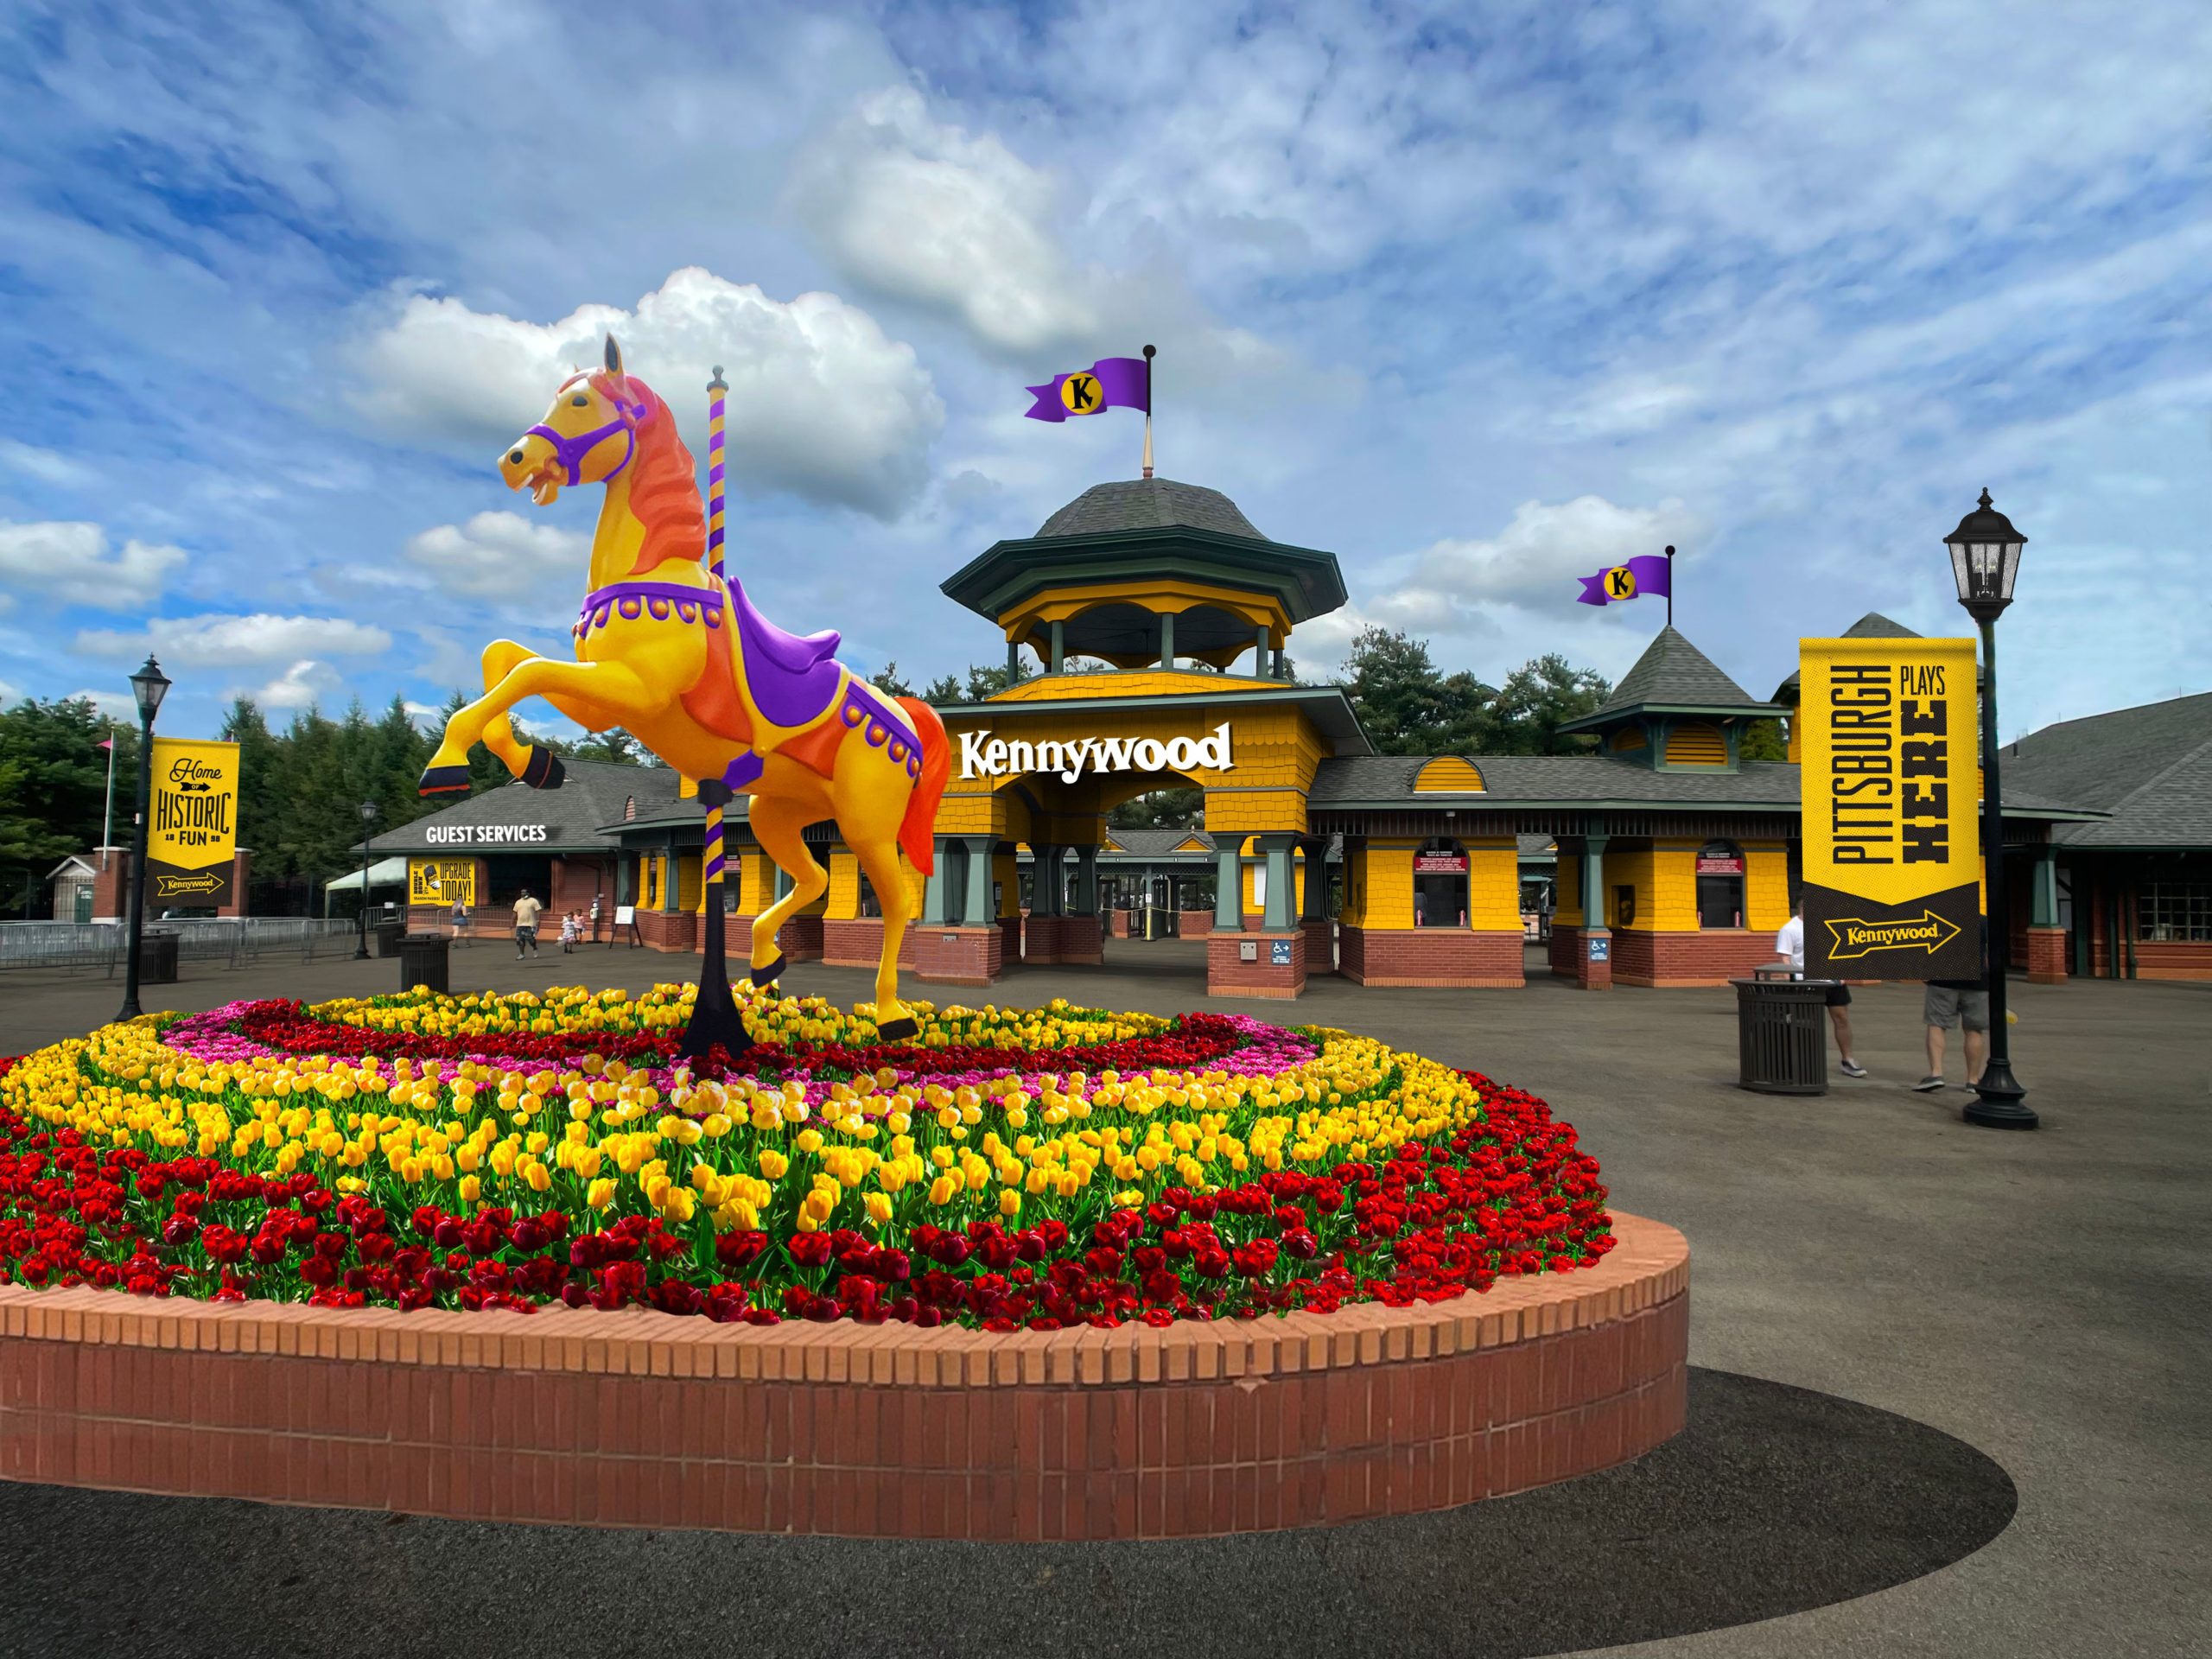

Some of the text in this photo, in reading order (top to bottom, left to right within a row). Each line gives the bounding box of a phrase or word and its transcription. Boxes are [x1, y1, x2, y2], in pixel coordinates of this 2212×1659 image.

[1070, 377, 1094, 410] K
[1611, 570, 1630, 595] K
[1900, 665, 1945, 696] PLAYS
[957, 721, 1236, 785] Kennywood
[1830, 665, 1893, 864] PITTSBURGH
[169, 758, 222, 782] Home
[1900, 700, 1949, 864] HERE
[156, 788, 231, 835] HISTORIC
[179, 830, 207, 846] FUN
[426, 824, 546, 843] GUEST SERVICES
[440, 862, 471, 879] UPGRADE
[168, 879, 213, 890] Kennywood
[440, 880, 471, 901] TODAY!
[1847, 923, 1938, 945] Kennywood
